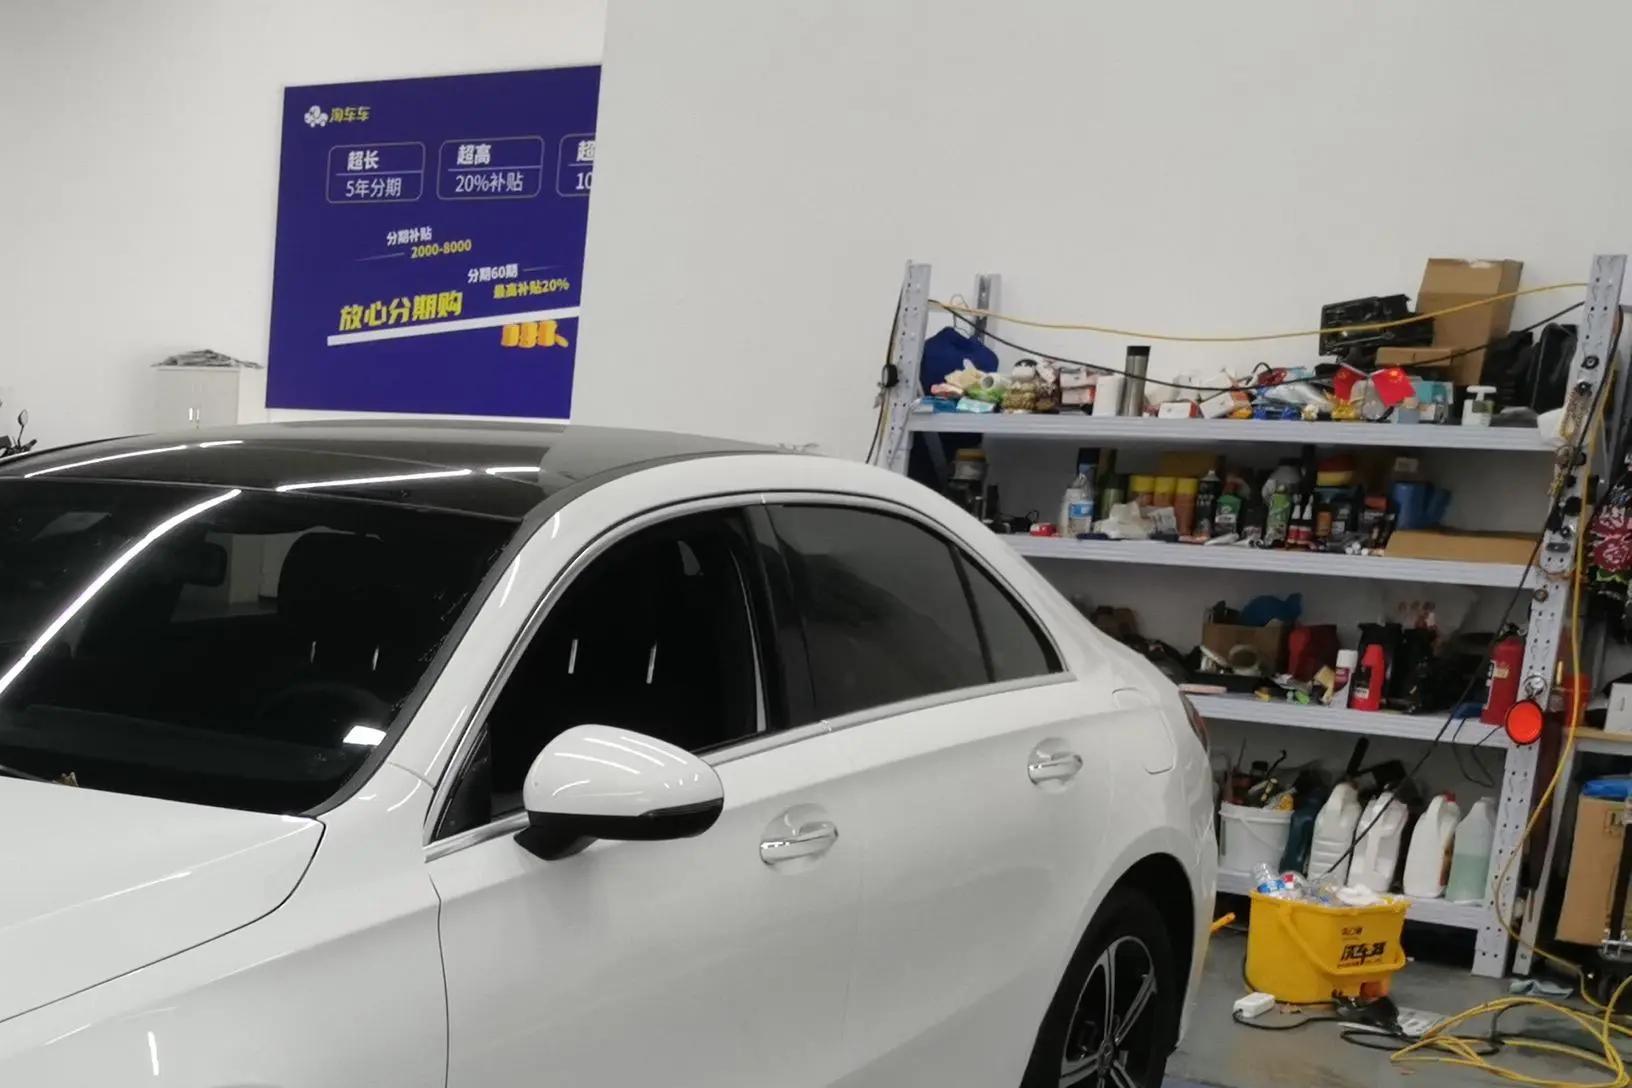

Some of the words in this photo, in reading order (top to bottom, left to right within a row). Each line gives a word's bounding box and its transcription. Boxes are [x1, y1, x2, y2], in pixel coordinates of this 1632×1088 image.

[329, 106, 371, 122] 淘车车
[347, 150, 380, 171] 超长
[456, 143, 492, 165] 超高
[345, 177, 403, 198] 5年分期
[455, 171, 525, 193] 20%补贴
[386, 226, 433, 246] 分期补贴
[410, 238, 473, 259] 2000-8000
[467, 263, 519, 284] 分期60期
[493, 278, 571, 299] 最高补贴20%
[338, 290, 464, 332] 放心分期购
